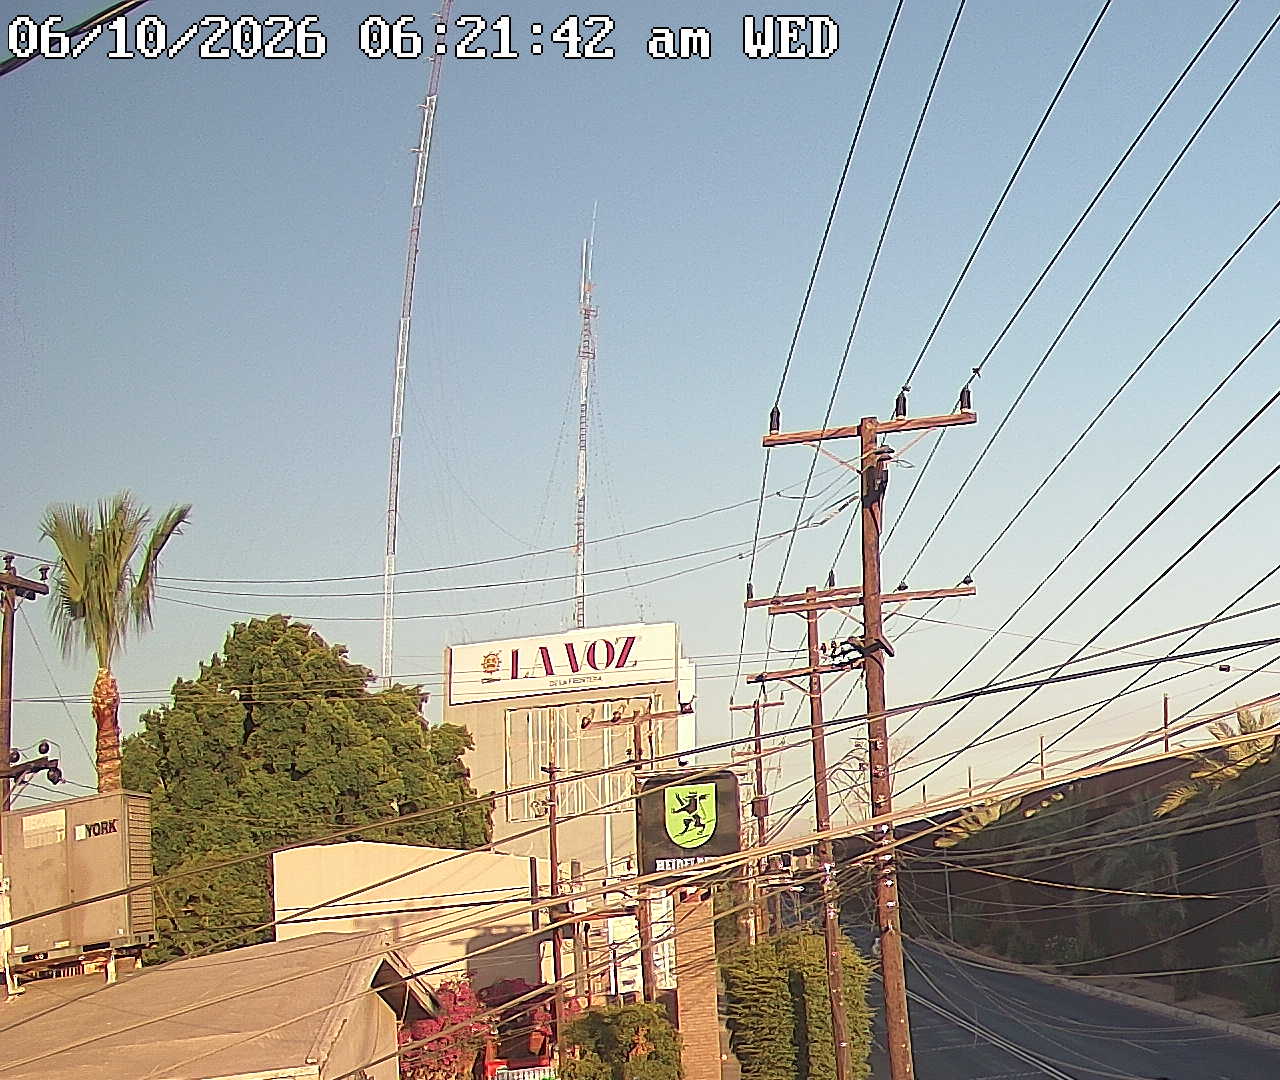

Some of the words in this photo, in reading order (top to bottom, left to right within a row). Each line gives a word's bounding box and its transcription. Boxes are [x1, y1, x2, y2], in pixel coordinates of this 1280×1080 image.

[511, 646, 555, 680] LA
[564, 636, 638, 674] VOZ
[85, 819, 119, 838] YORK
